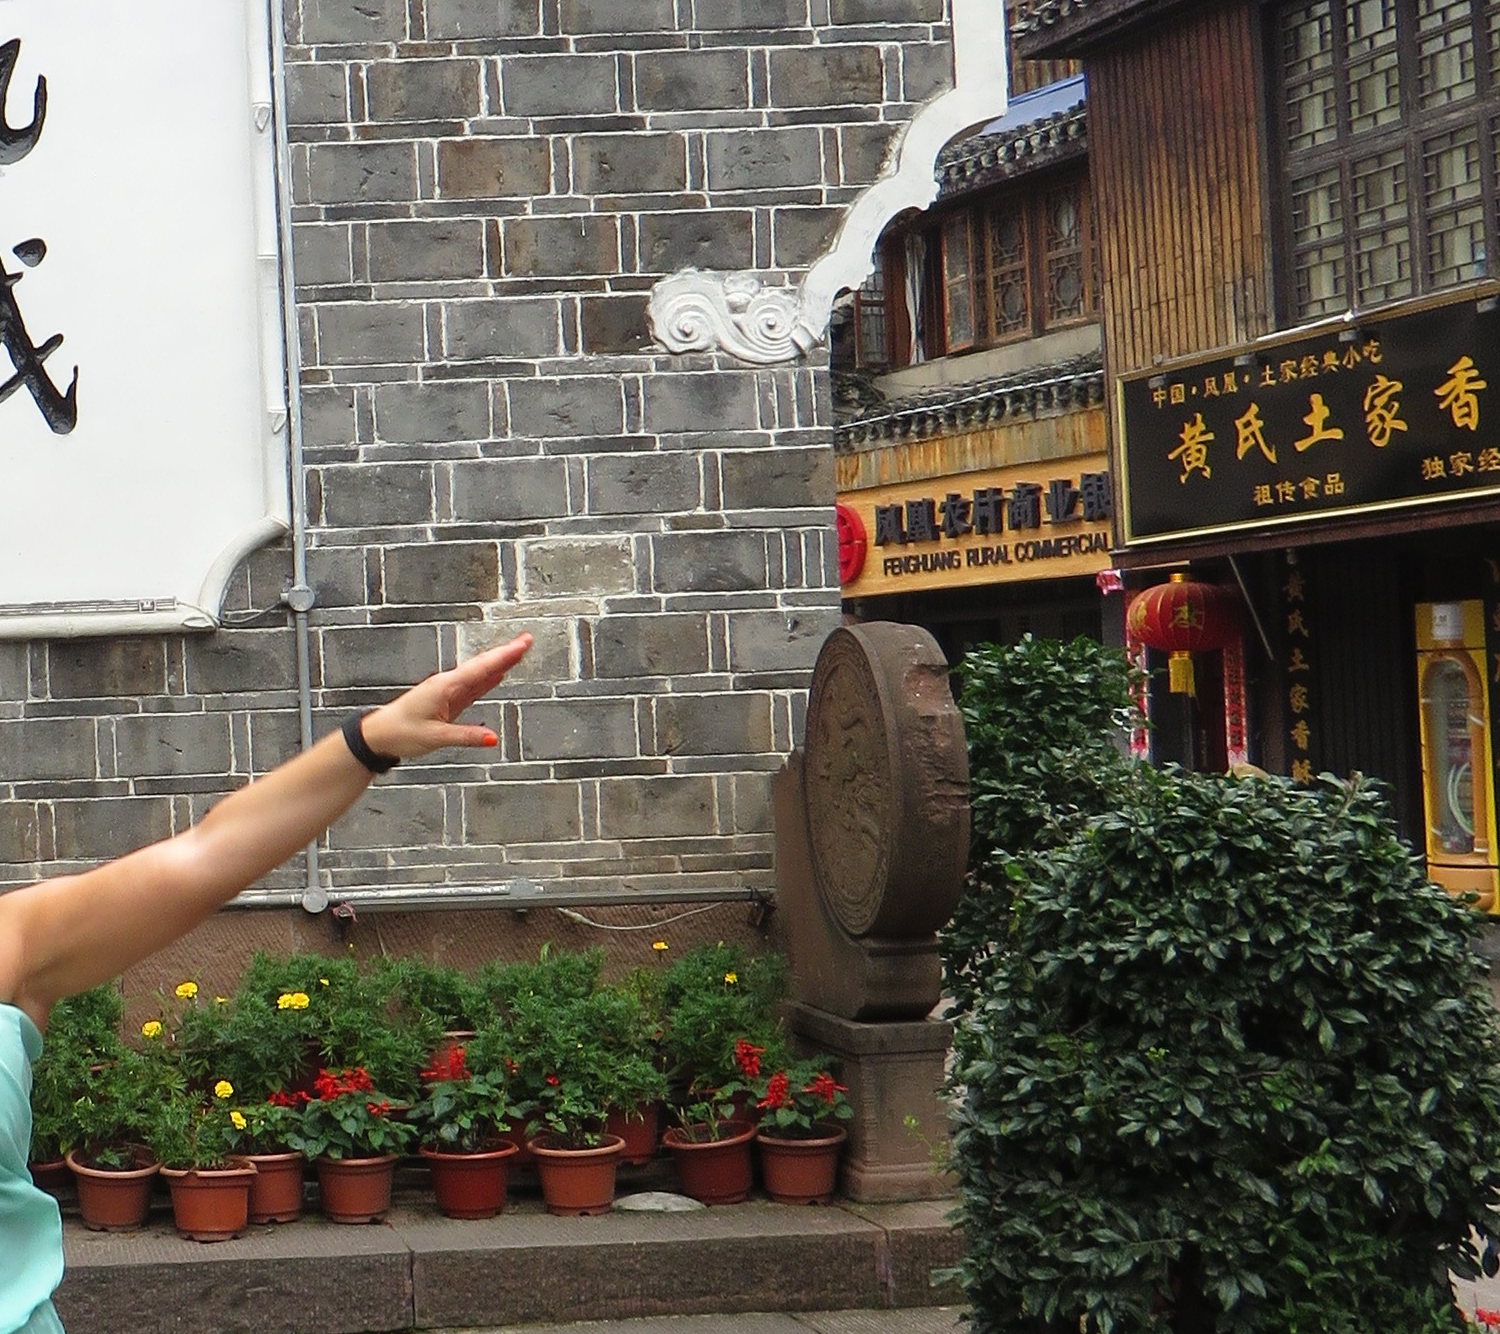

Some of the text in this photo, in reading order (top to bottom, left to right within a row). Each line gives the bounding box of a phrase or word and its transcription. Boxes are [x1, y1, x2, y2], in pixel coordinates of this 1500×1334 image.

[1167, 354, 1488, 484] 黄氏土家香
[1253, 472, 1345, 507] 祖传食品
[883, 531, 1112, 576] FENGHUANG RURAL COMMERCIAL
